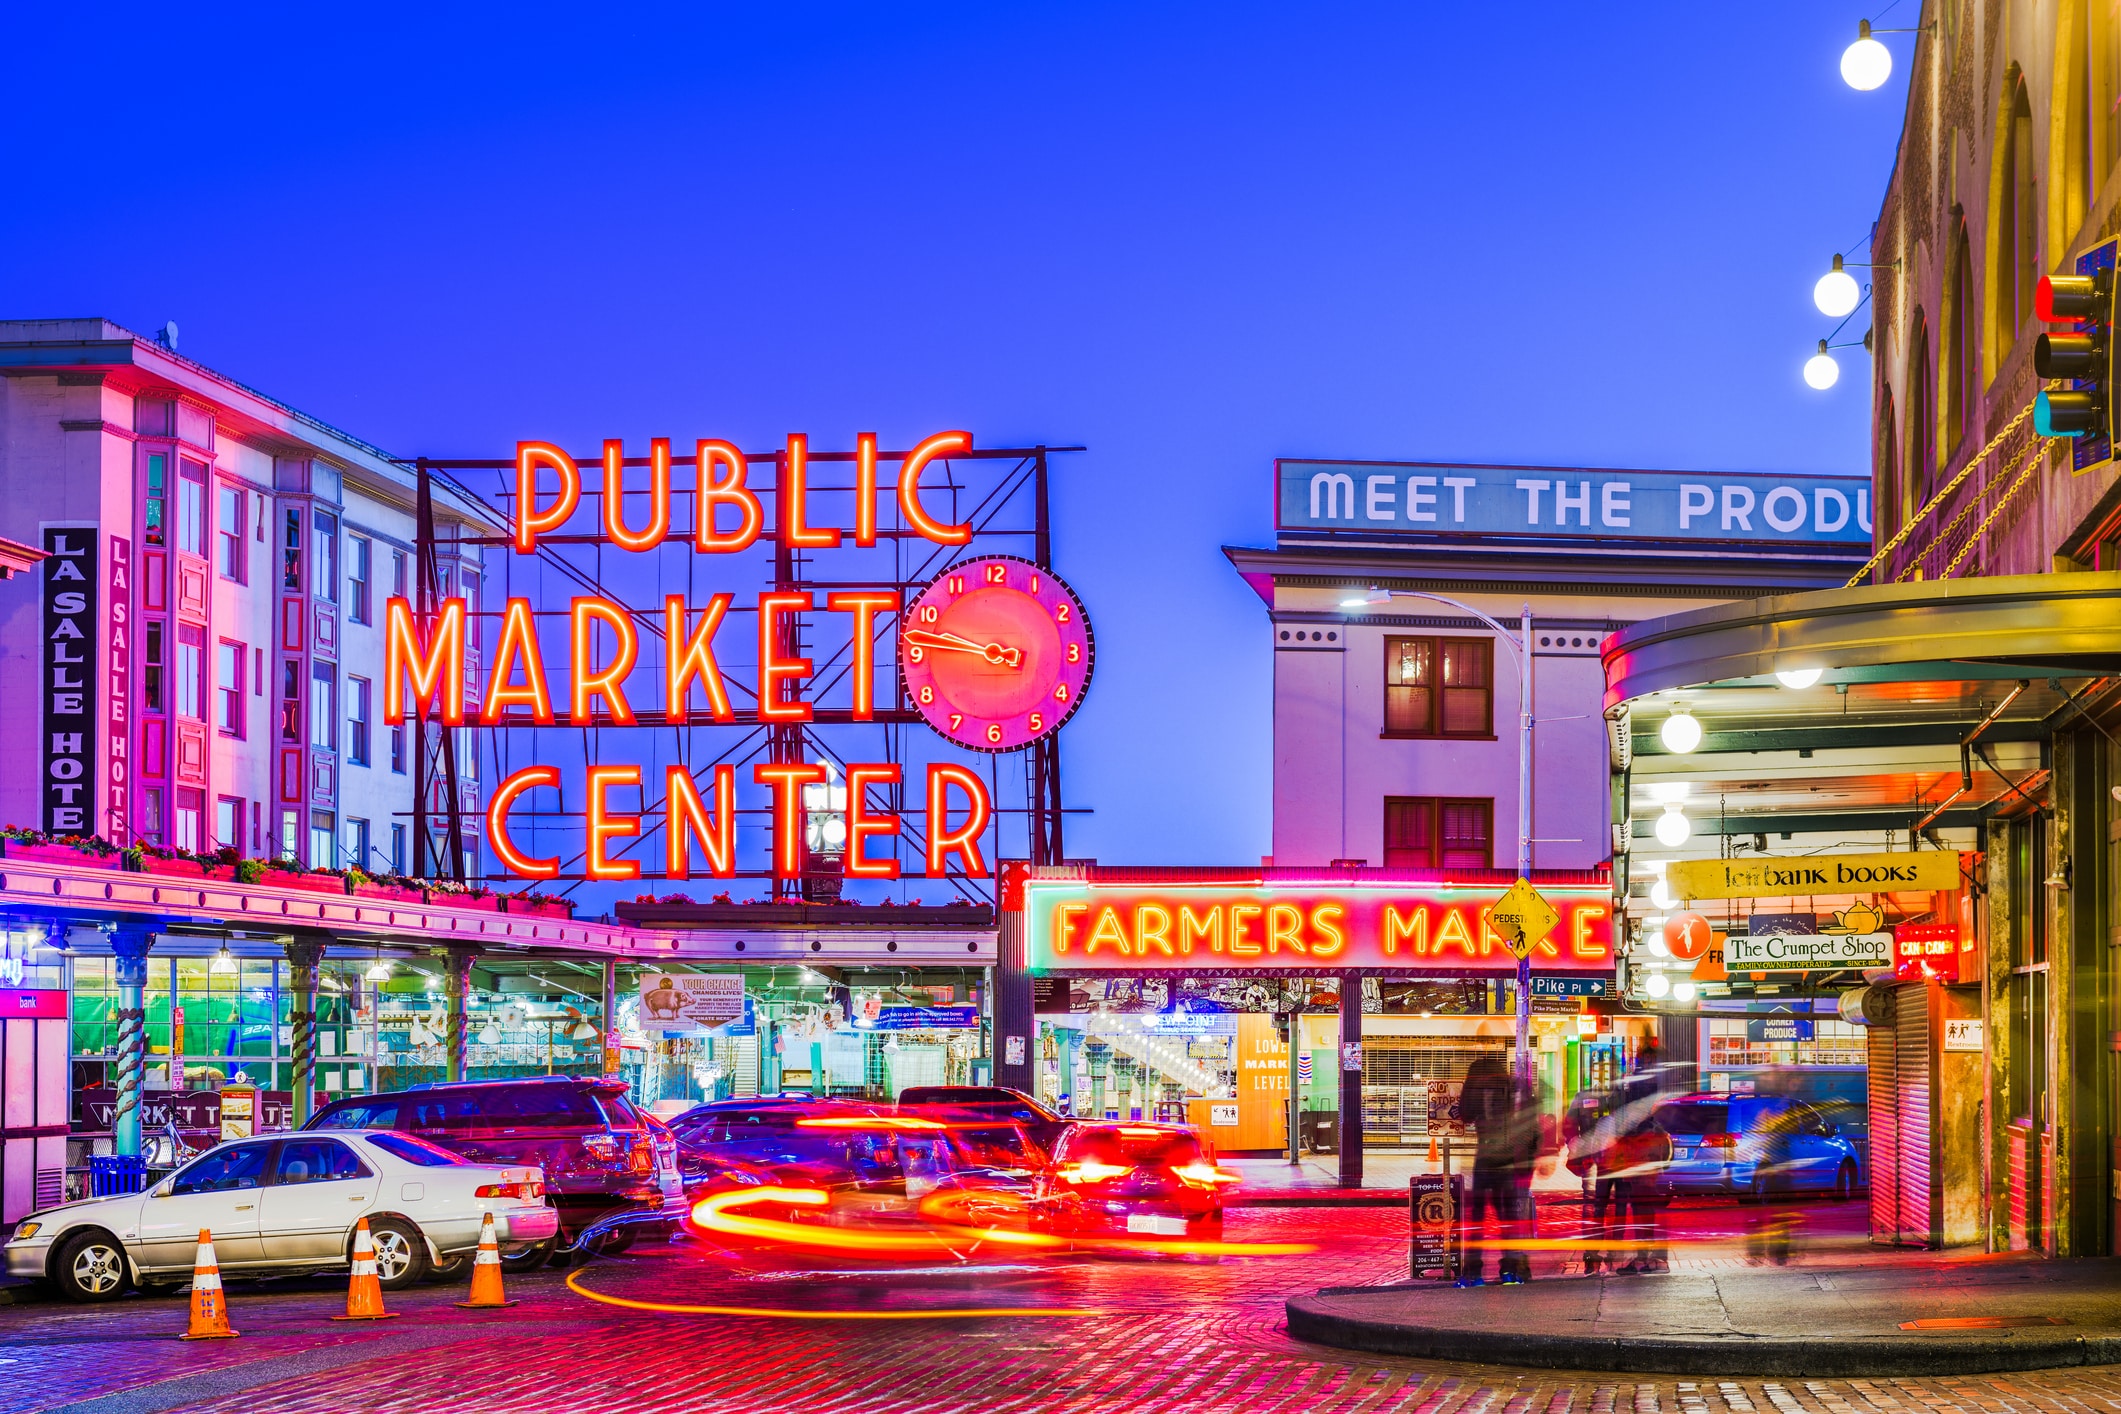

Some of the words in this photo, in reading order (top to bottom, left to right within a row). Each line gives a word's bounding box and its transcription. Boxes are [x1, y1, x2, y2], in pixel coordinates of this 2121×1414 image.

[516, 430, 973, 555] PUBLIC
[1310, 473, 1476, 522] MEET
[1516, 479, 1631, 527] THE
[51, 535, 86, 581] LA
[111, 541, 127, 589] LA
[987, 566, 1005, 582] 12
[950, 578, 963, 594] 11
[1032, 577, 1038, 593] 1
[920, 606, 938, 623] 10
[1058, 605, 1069, 621] 2
[51, 592, 86, 714] SALLE
[384, 592, 900, 726] MARKET
[910, 647, 923, 663] 9
[1068, 645, 1079, 661] 3
[111, 602, 127, 723] SALLE
[920, 687, 933, 703] 8
[1056, 685, 1067, 701] 4
[951, 715, 962, 730] 7
[1030, 714, 1042, 730] 5
[987, 726, 1001, 742] 6
[51, 732, 85, 838] HOTE
[486, 763, 992, 880] CENTER
[1838, 862, 1918, 883] books
[1494, 914, 1551, 924] PEDESTS
[1056, 903, 1343, 954] FARMERS
[1731, 939, 1763, 960] The
[1766, 937, 1837, 961] Crumpet
[1842, 936, 1887, 960] Shop
[1901, 941, 1920, 956] CAN
[1925, 940, 1945, 955] CAN
[682, 979, 706, 990] YOUR
[707, 979, 742, 990] CHANGE
[1537, 979, 1565, 993] Pike
[20, 996, 37, 1008] bank
[1764, 1028, 1796, 1038] PRODUCE
[1256, 1039, 1288, 1053] LOWE
[1245, 1060, 1287, 1068] MARK
[1254, 1076, 1290, 1090] LEVEL
[1429, 1082, 1446, 1092] NO
[103, 1107, 196, 1124] MRKT
[1428, 1205, 1444, 1219] R
